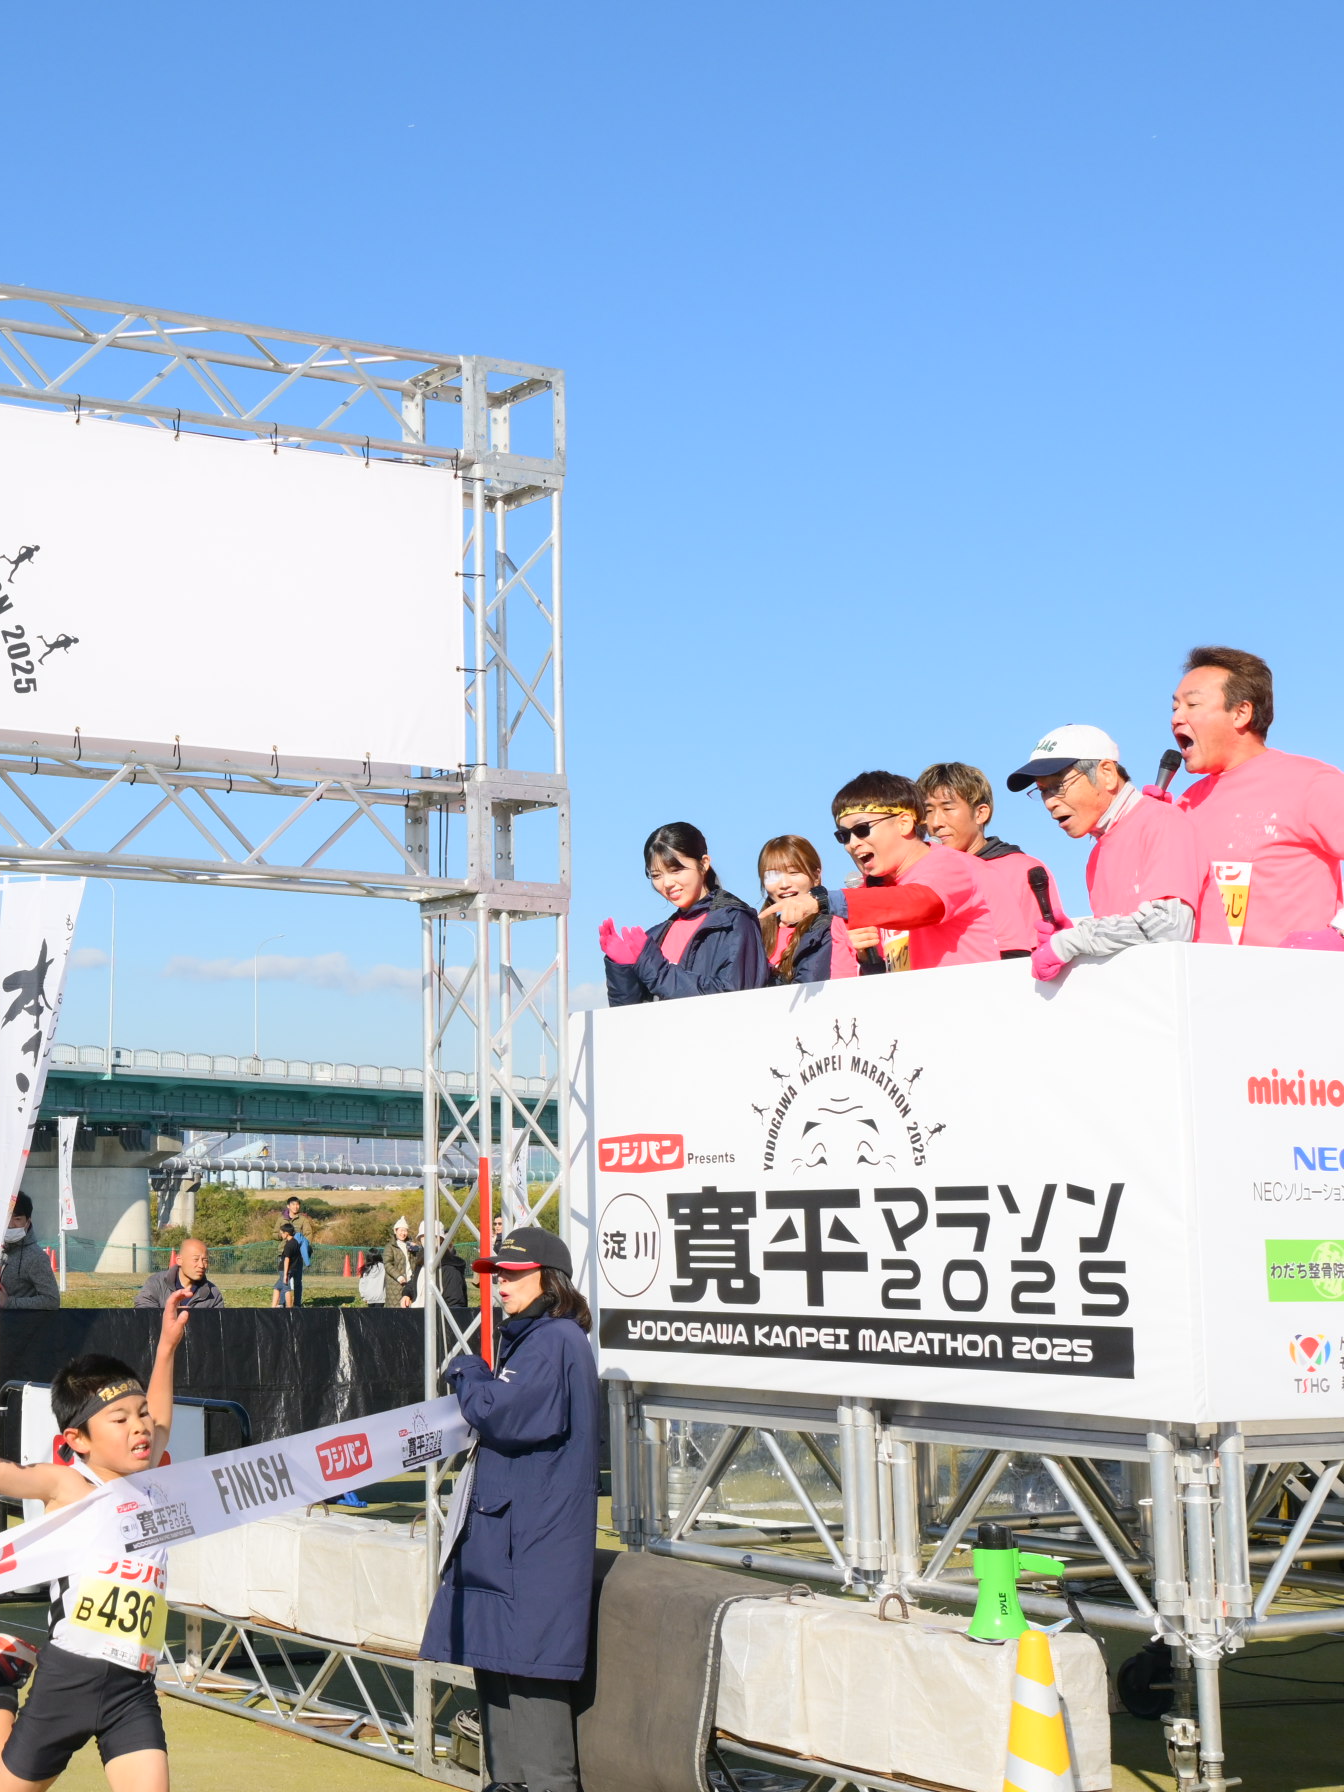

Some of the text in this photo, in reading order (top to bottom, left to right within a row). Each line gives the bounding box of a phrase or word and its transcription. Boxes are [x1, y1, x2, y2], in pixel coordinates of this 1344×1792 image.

[1, 624, 38, 694] 2025
[763, 1054, 927, 1171] YODOGAWA KANPEI MARATHON 2025
[602, 1139, 736, 1166] フジパン Presents
[602, 1230, 657, 1262] 淀川
[880, 1259, 1130, 1318] 2025
[1270, 1262, 1344, 1280] わだち整骨院
[627, 1320, 1093, 1363] YODOGAWA KANPEI MARATHON 2025
[1294, 1378, 1330, 1393] TSHG
[319, 1441, 371, 1474] フジパン
[211, 1453, 295, 1514] FINISH
